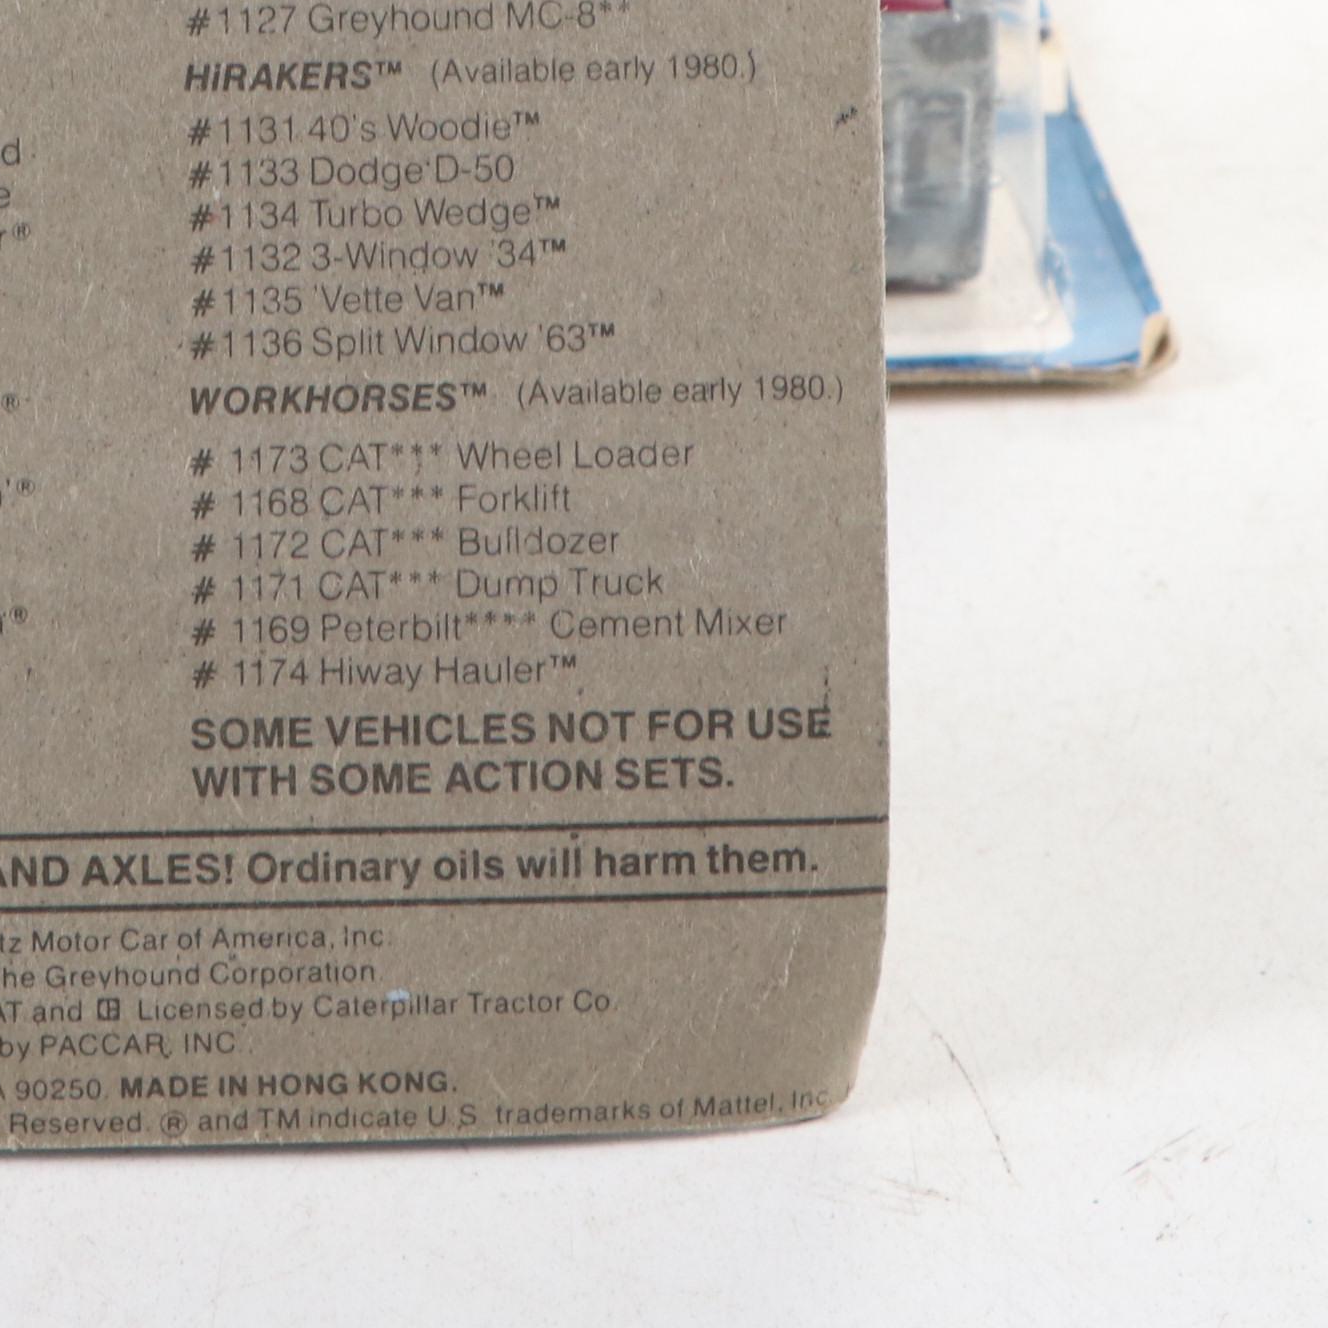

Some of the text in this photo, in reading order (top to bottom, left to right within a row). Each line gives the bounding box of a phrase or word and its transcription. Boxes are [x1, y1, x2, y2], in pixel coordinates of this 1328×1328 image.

[308, 3, 493, 38] Greyhound
[586, 56, 654, 85] early
[311, 154, 514, 191] Dodge D-50
[312, 199, 402, 228] Turbo
[312, 242, 478, 273] 3-Window
[313, 326, 527, 361] Split Window
[673, 377, 742, 406] early
[457, 441, 693, 470] Wheel Loader
[459, 484, 569, 513] Forklift
[457, 567, 662, 603] Dump Truck
[550, 607, 786, 639] Cement Mixer
[321, 658, 421, 691] Hiway
[191, 702, 832, 751] SOME VEHICLES NOT FOR USE
[192, 756, 734, 798] WITH SOME ACTION SETS.
[82, 853, 233, 886] AXLES!
[248, 851, 421, 890] Ordinary
[434, 849, 504, 881] oils
[517, 847, 581, 879] will
[595, 847, 695, 877] harm
[706, 843, 818, 875] them.
[32, 931, 110, 952] Motor
[120, 928, 167, 951] Car
[46, 965, 200, 994] Greyhound
[210, 962, 374, 988] Corporation
[314, 995, 457, 1020] Caterpillar
[468, 992, 562, 1014] Tractor
[121, 1071, 457, 1098] MADE IN HONG KONG.
[258, 1108, 299, 1129] TM
[310, 1108, 417, 1128] indicate
[496, 1102, 650, 1124] trademarks
